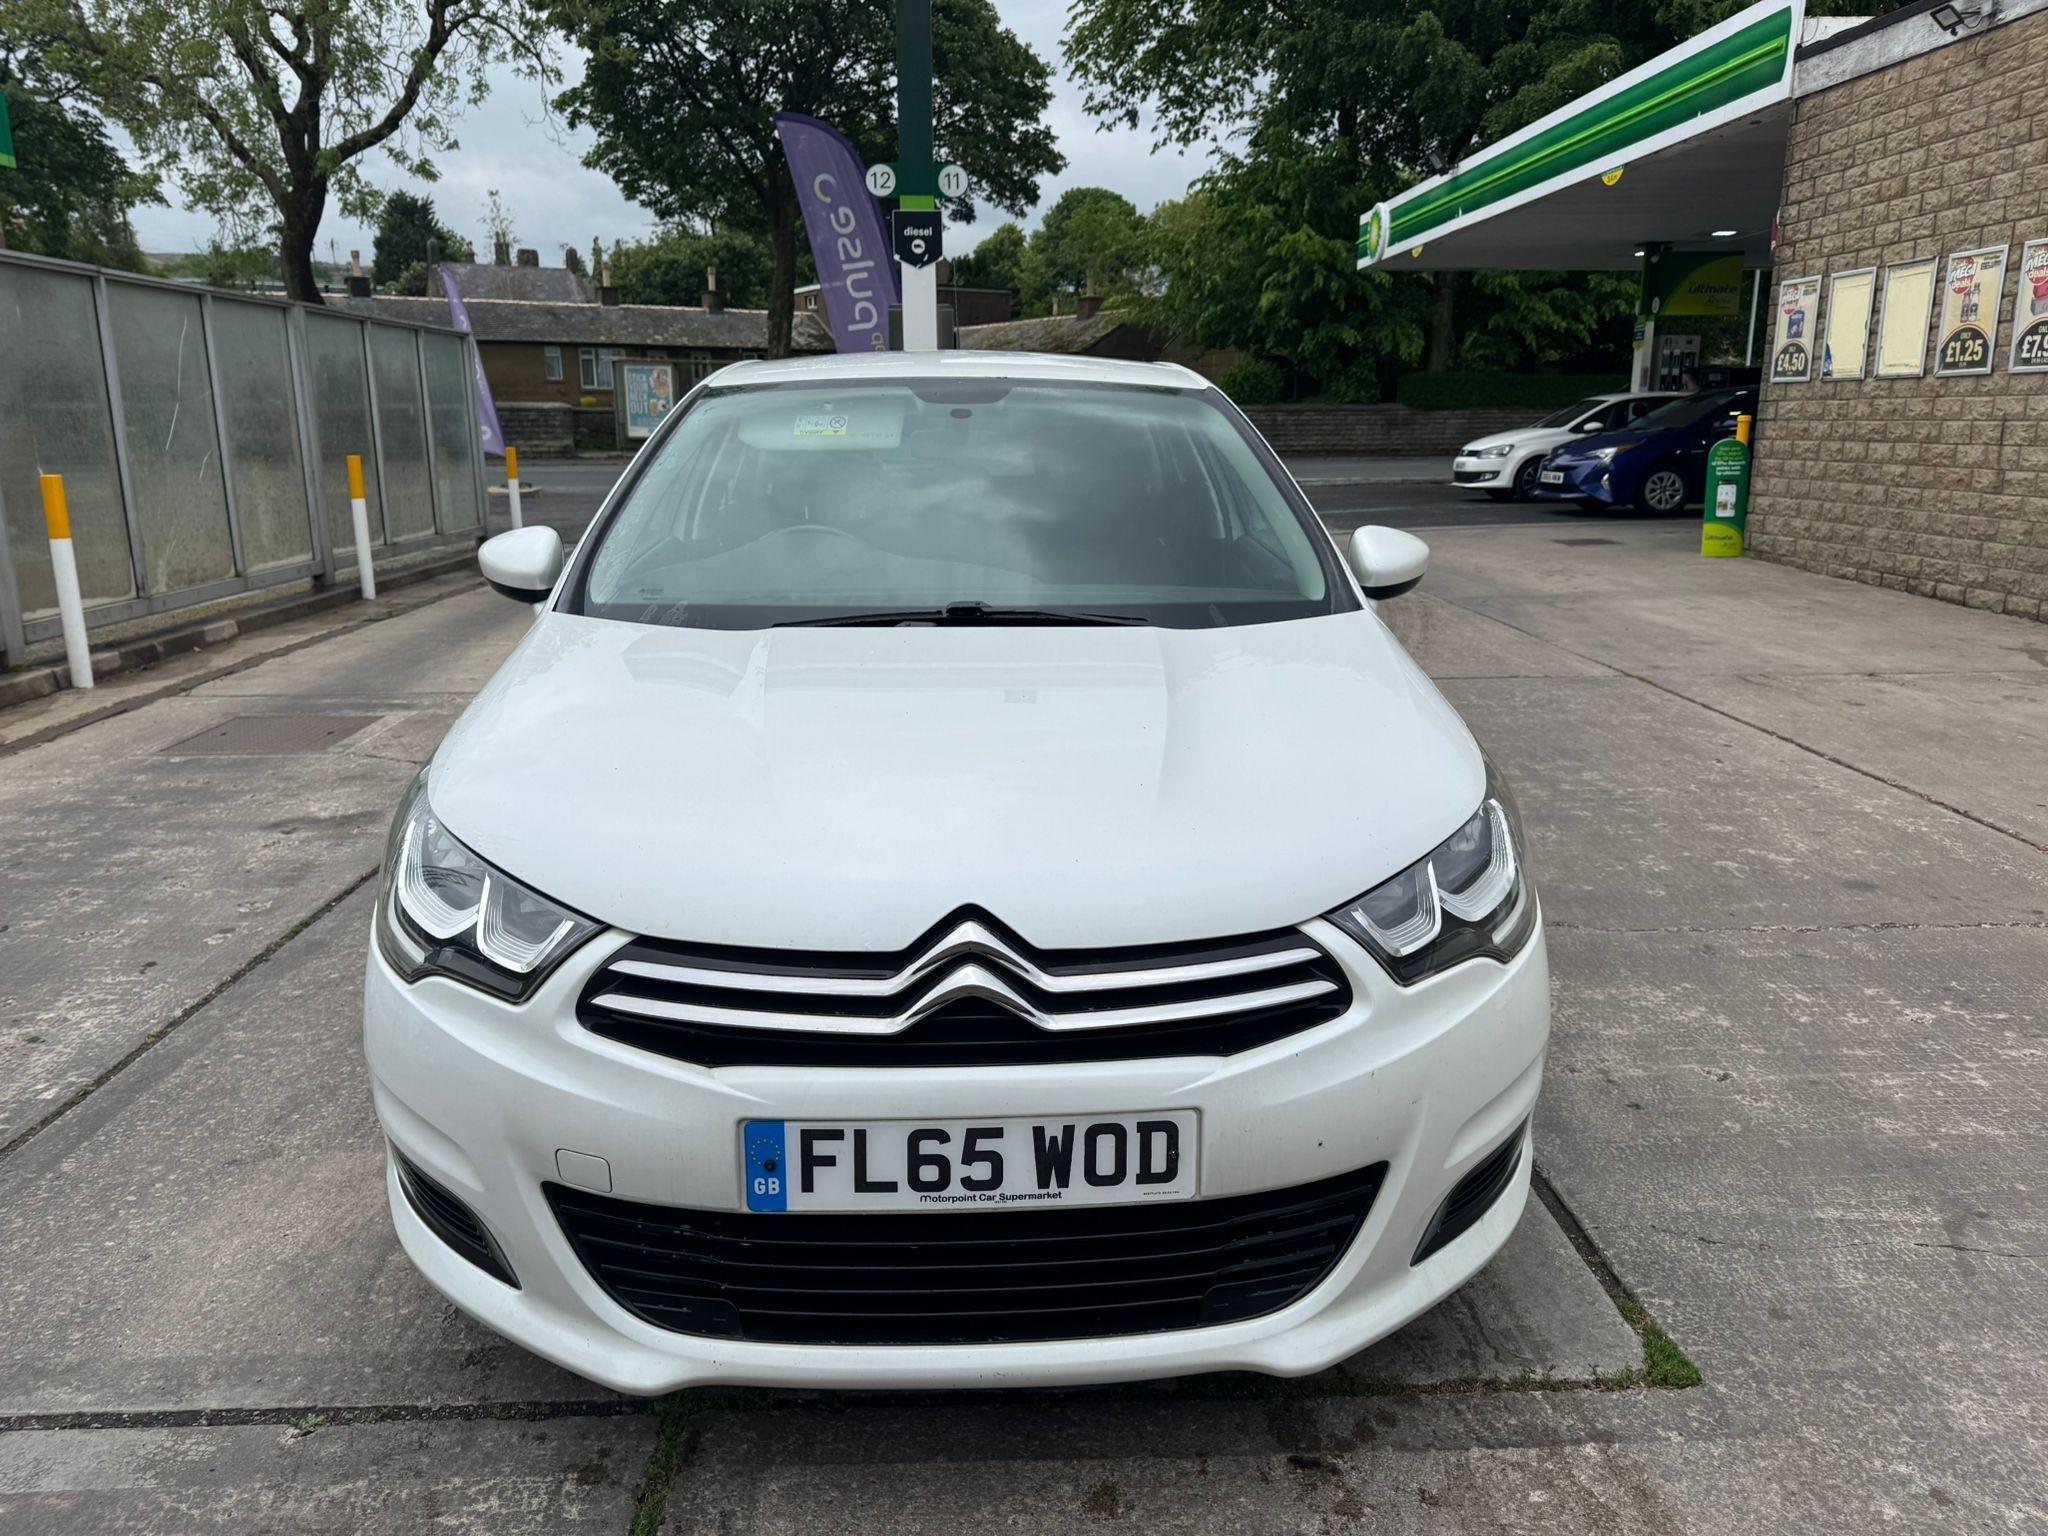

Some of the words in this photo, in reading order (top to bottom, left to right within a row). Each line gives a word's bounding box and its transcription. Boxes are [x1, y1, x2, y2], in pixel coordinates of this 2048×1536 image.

[870, 171, 891, 189] 12
[943, 172, 961, 190] 11
[903, 226, 933, 237] diesel
[1945, 339, 1984, 363] £1.25
[1777, 353, 1805, 372] £4.50
[800, 1127, 1004, 1194] FL65
[1031, 1120, 1180, 1190] WOD
[753, 1177, 780, 1195] GB
[979, 1192, 997, 1202] Car
[998, 1190, 1063, 1203] Supermarket
